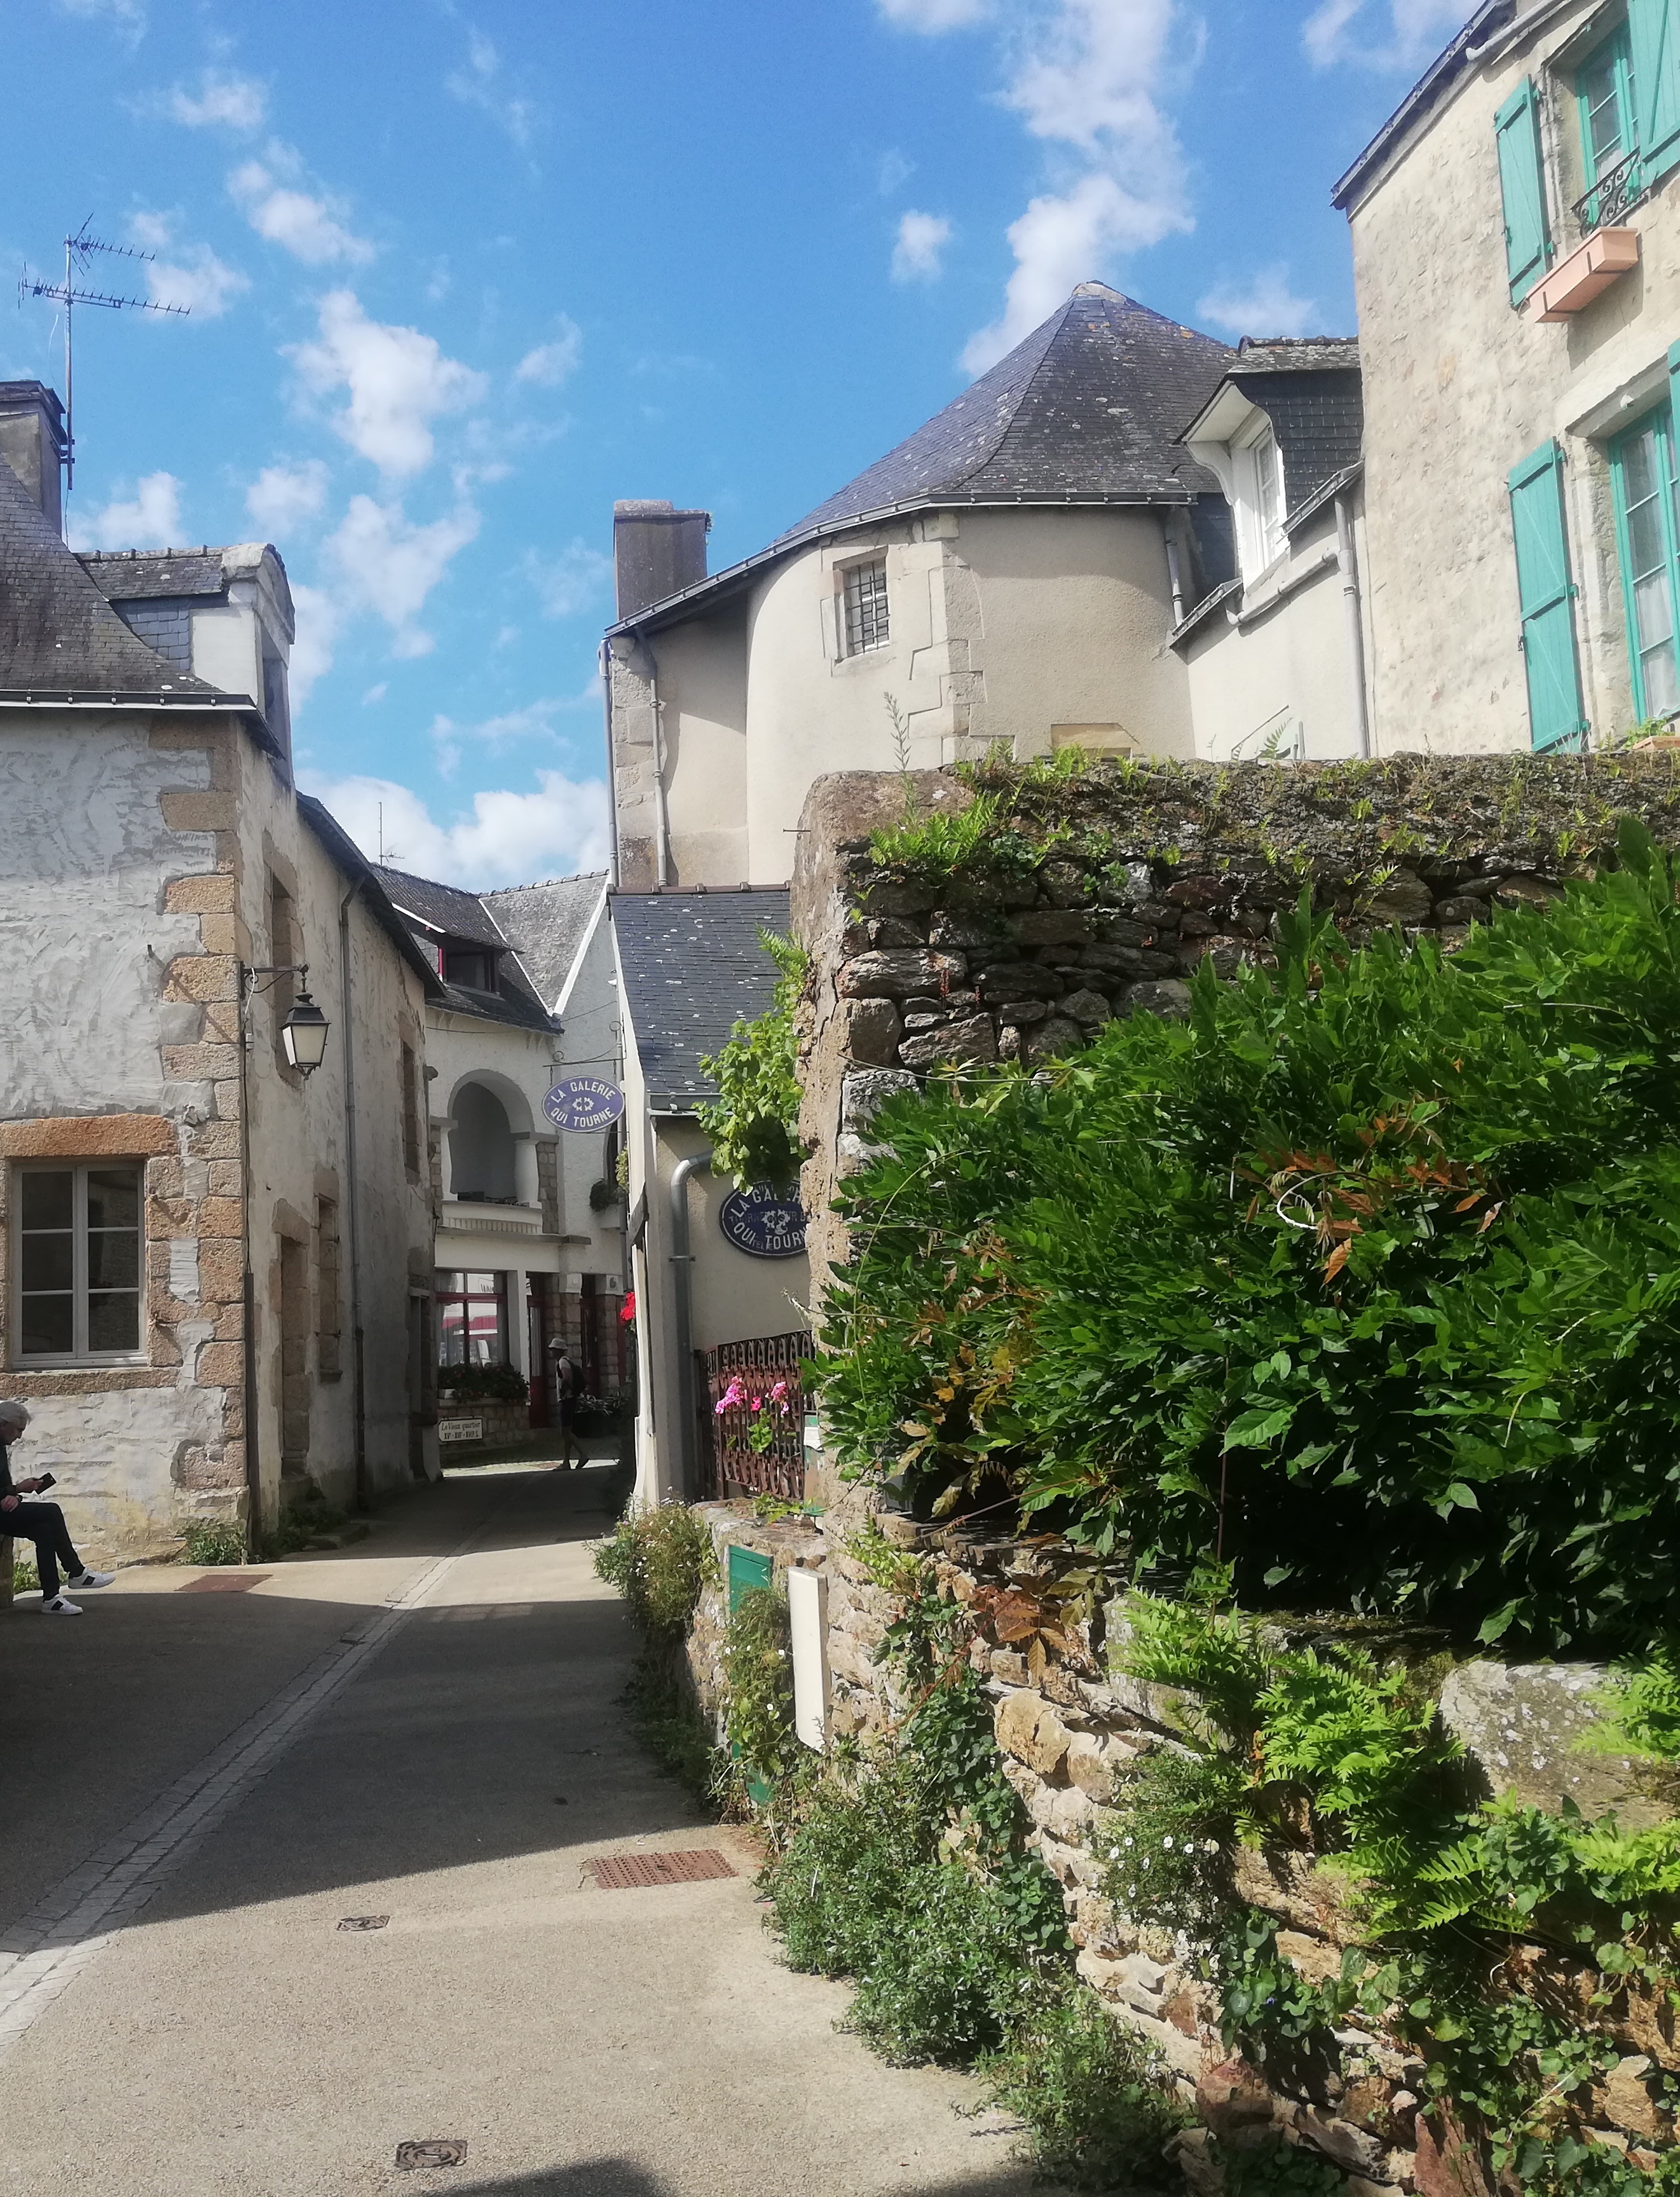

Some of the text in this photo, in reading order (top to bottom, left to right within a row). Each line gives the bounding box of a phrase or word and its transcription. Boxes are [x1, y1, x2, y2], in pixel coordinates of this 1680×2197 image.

[550, 1081, 616, 1104] LA GALERIE
[550, 1107, 615, 1127] QUI TOURNE
[730, 1199, 751, 1218] LA
[734, 1222, 807, 1250] QUI TOURN
